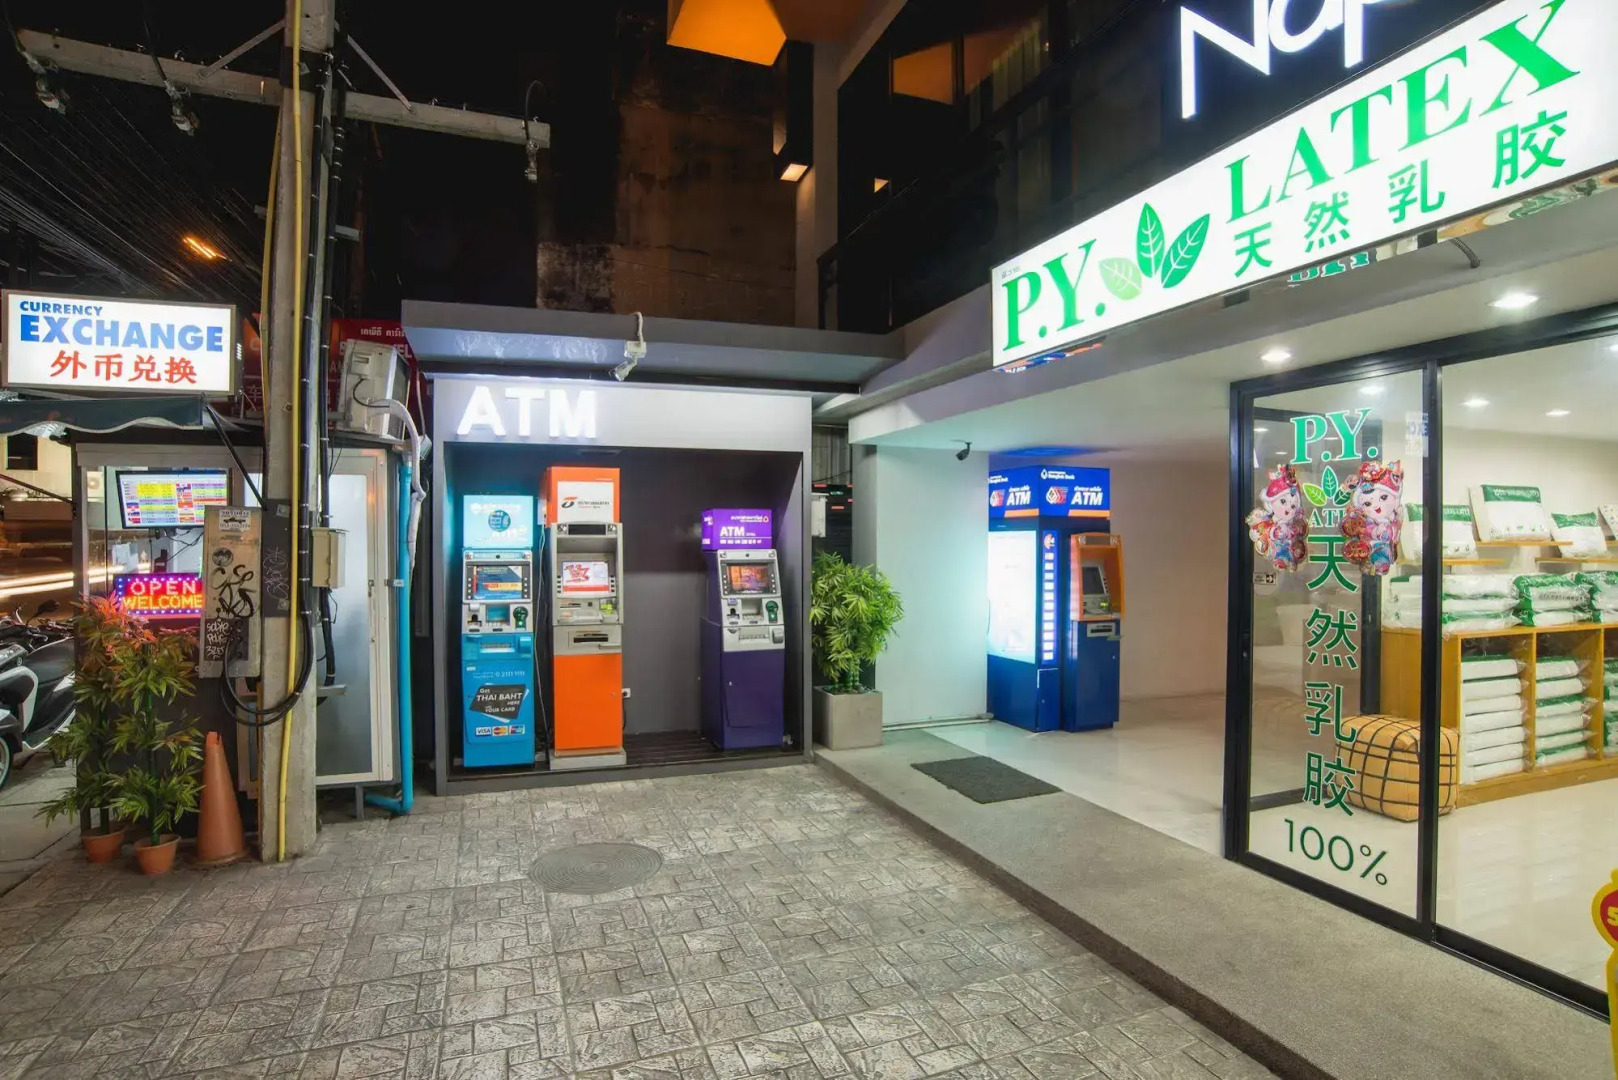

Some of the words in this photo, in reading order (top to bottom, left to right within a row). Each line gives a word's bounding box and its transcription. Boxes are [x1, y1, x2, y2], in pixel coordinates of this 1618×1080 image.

[1001, 238, 1106, 352] P.Y.
[1224, 0, 1581, 224] LATEX
[1234, 110, 1568, 278] 天然乳胶
[20, 301, 103, 316] CURRENCY
[20, 314, 223, 352] EXCHANGE
[50, 350, 197, 384] 外币兑换
[456, 385, 597, 438] ATM
[1289, 407, 1379, 464] P.Y.
[1006, 491, 1031, 506] ATM
[1071, 492, 1103, 506] ATM
[720, 526, 745, 537] ATM
[122, 594, 203, 610] WELCOME
[131, 580, 196, 596] OPEN
[1303, 533, 1358, 817] 天然乳胶
[476, 694, 497, 702] THAI
[499, 692, 523, 700] BAHT
[1284, 818, 1388, 886] 100%
